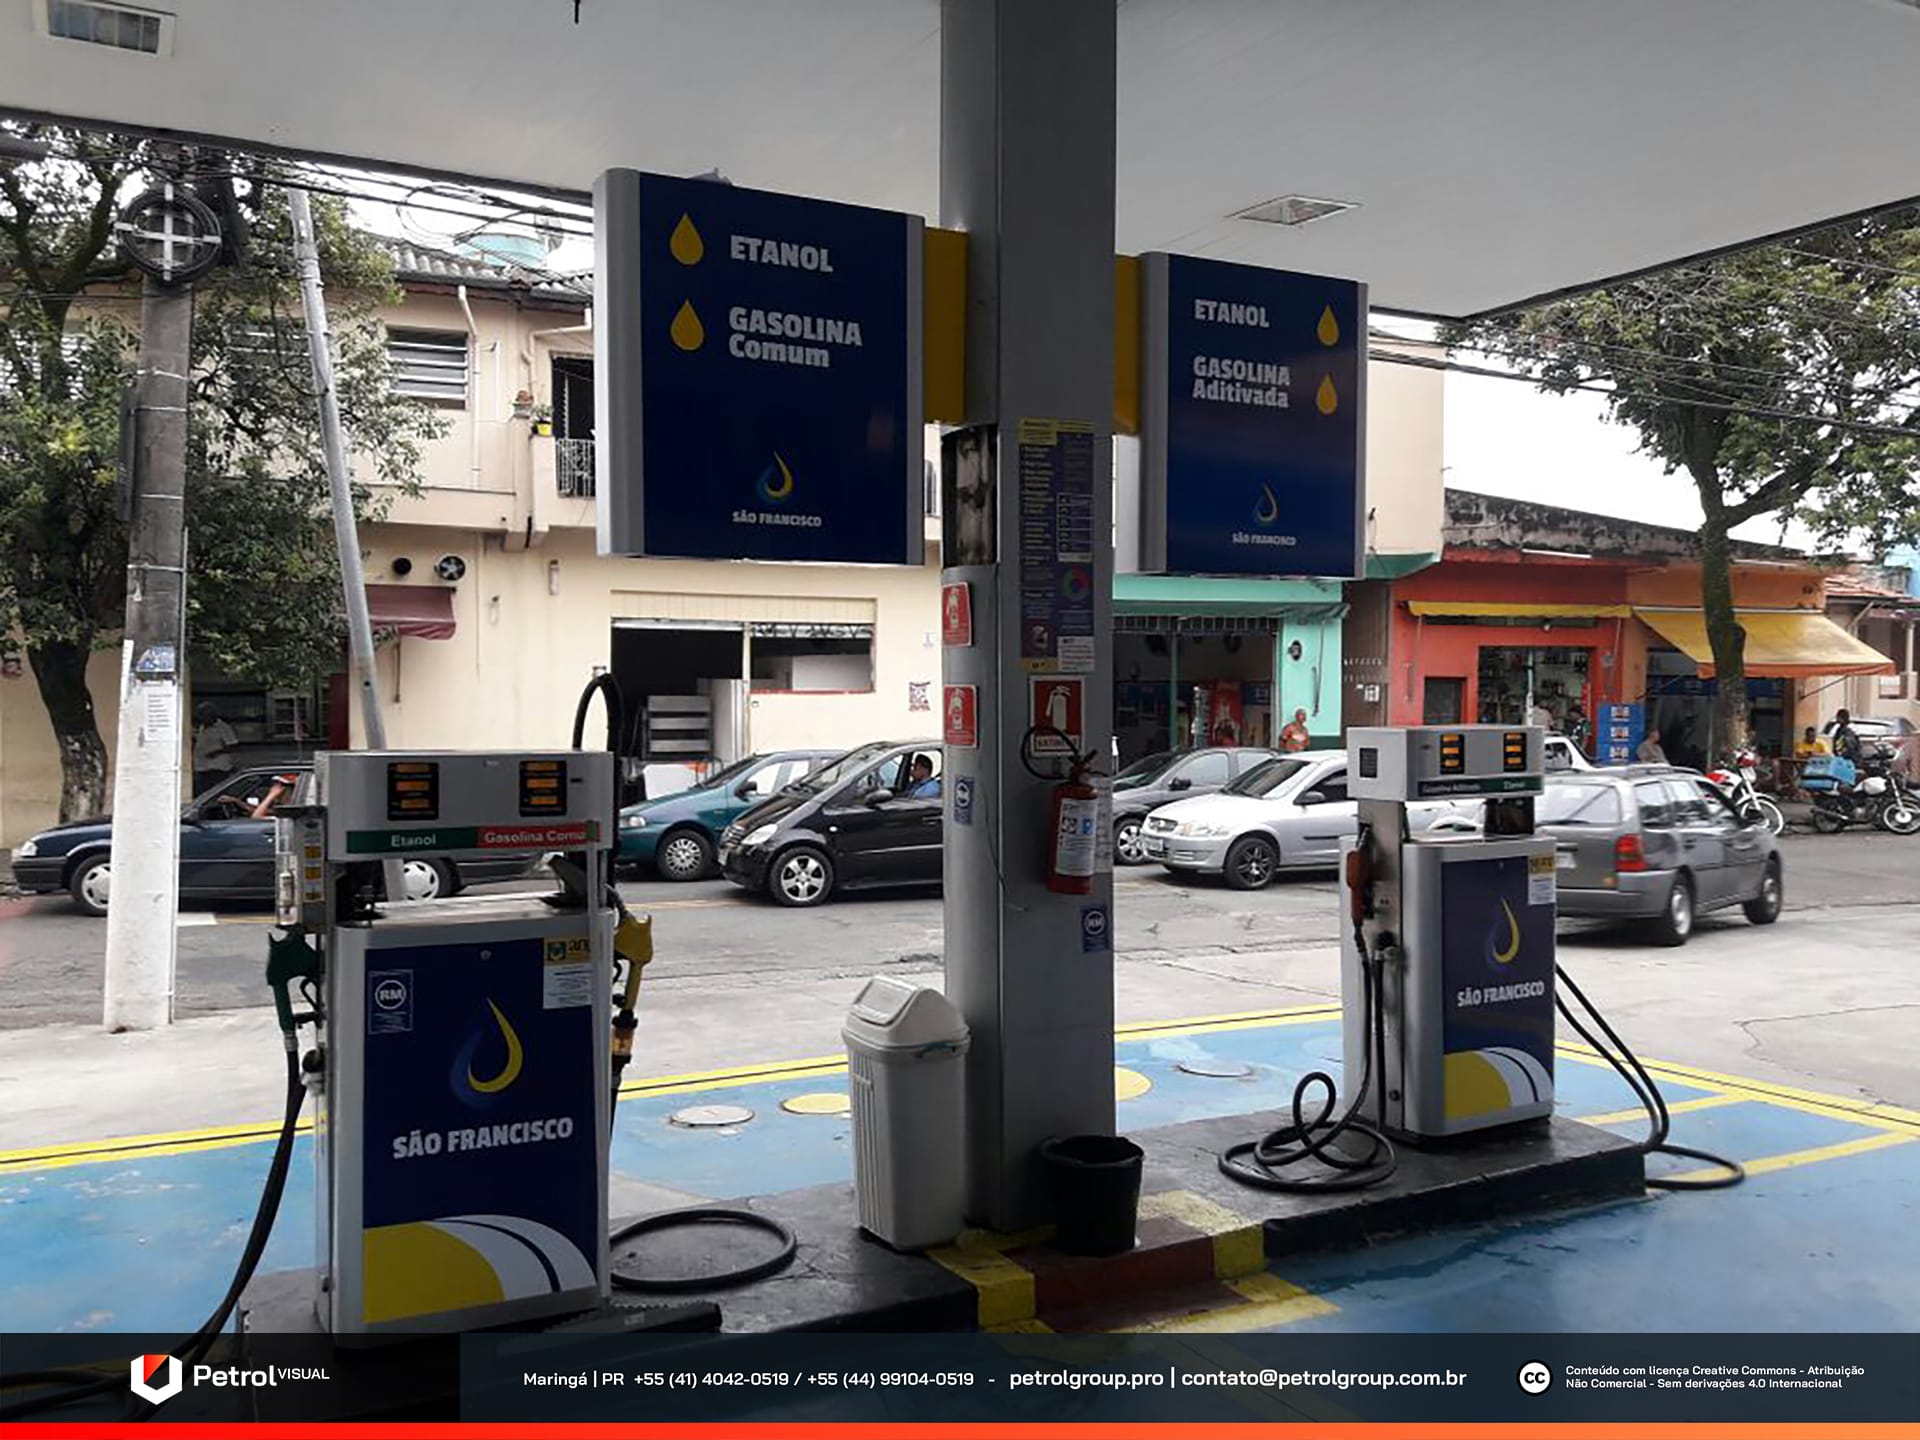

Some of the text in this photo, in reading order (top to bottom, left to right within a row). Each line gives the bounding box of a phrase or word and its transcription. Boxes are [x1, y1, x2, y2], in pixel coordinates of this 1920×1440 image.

[730, 234, 834, 273] ETANOL
[729, 306, 863, 347] GASOLINA
[1194, 299, 1270, 328] ETANOL
[729, 334, 830, 368] Comum
[1193, 356, 1290, 387] GASOLINA
[1192, 379, 1289, 408] Aditivada
[732, 509, 822, 527] SÃO FRANCISCO
[391, 834, 437, 848] Etanol
[484, 829, 587, 844] Gasolina Comu
[379, 988, 404, 1001] RM
[1458, 980, 1545, 1007] SÃO FRANCISCO
[393, 1117, 574, 1159] SÃO FRANCISCO
